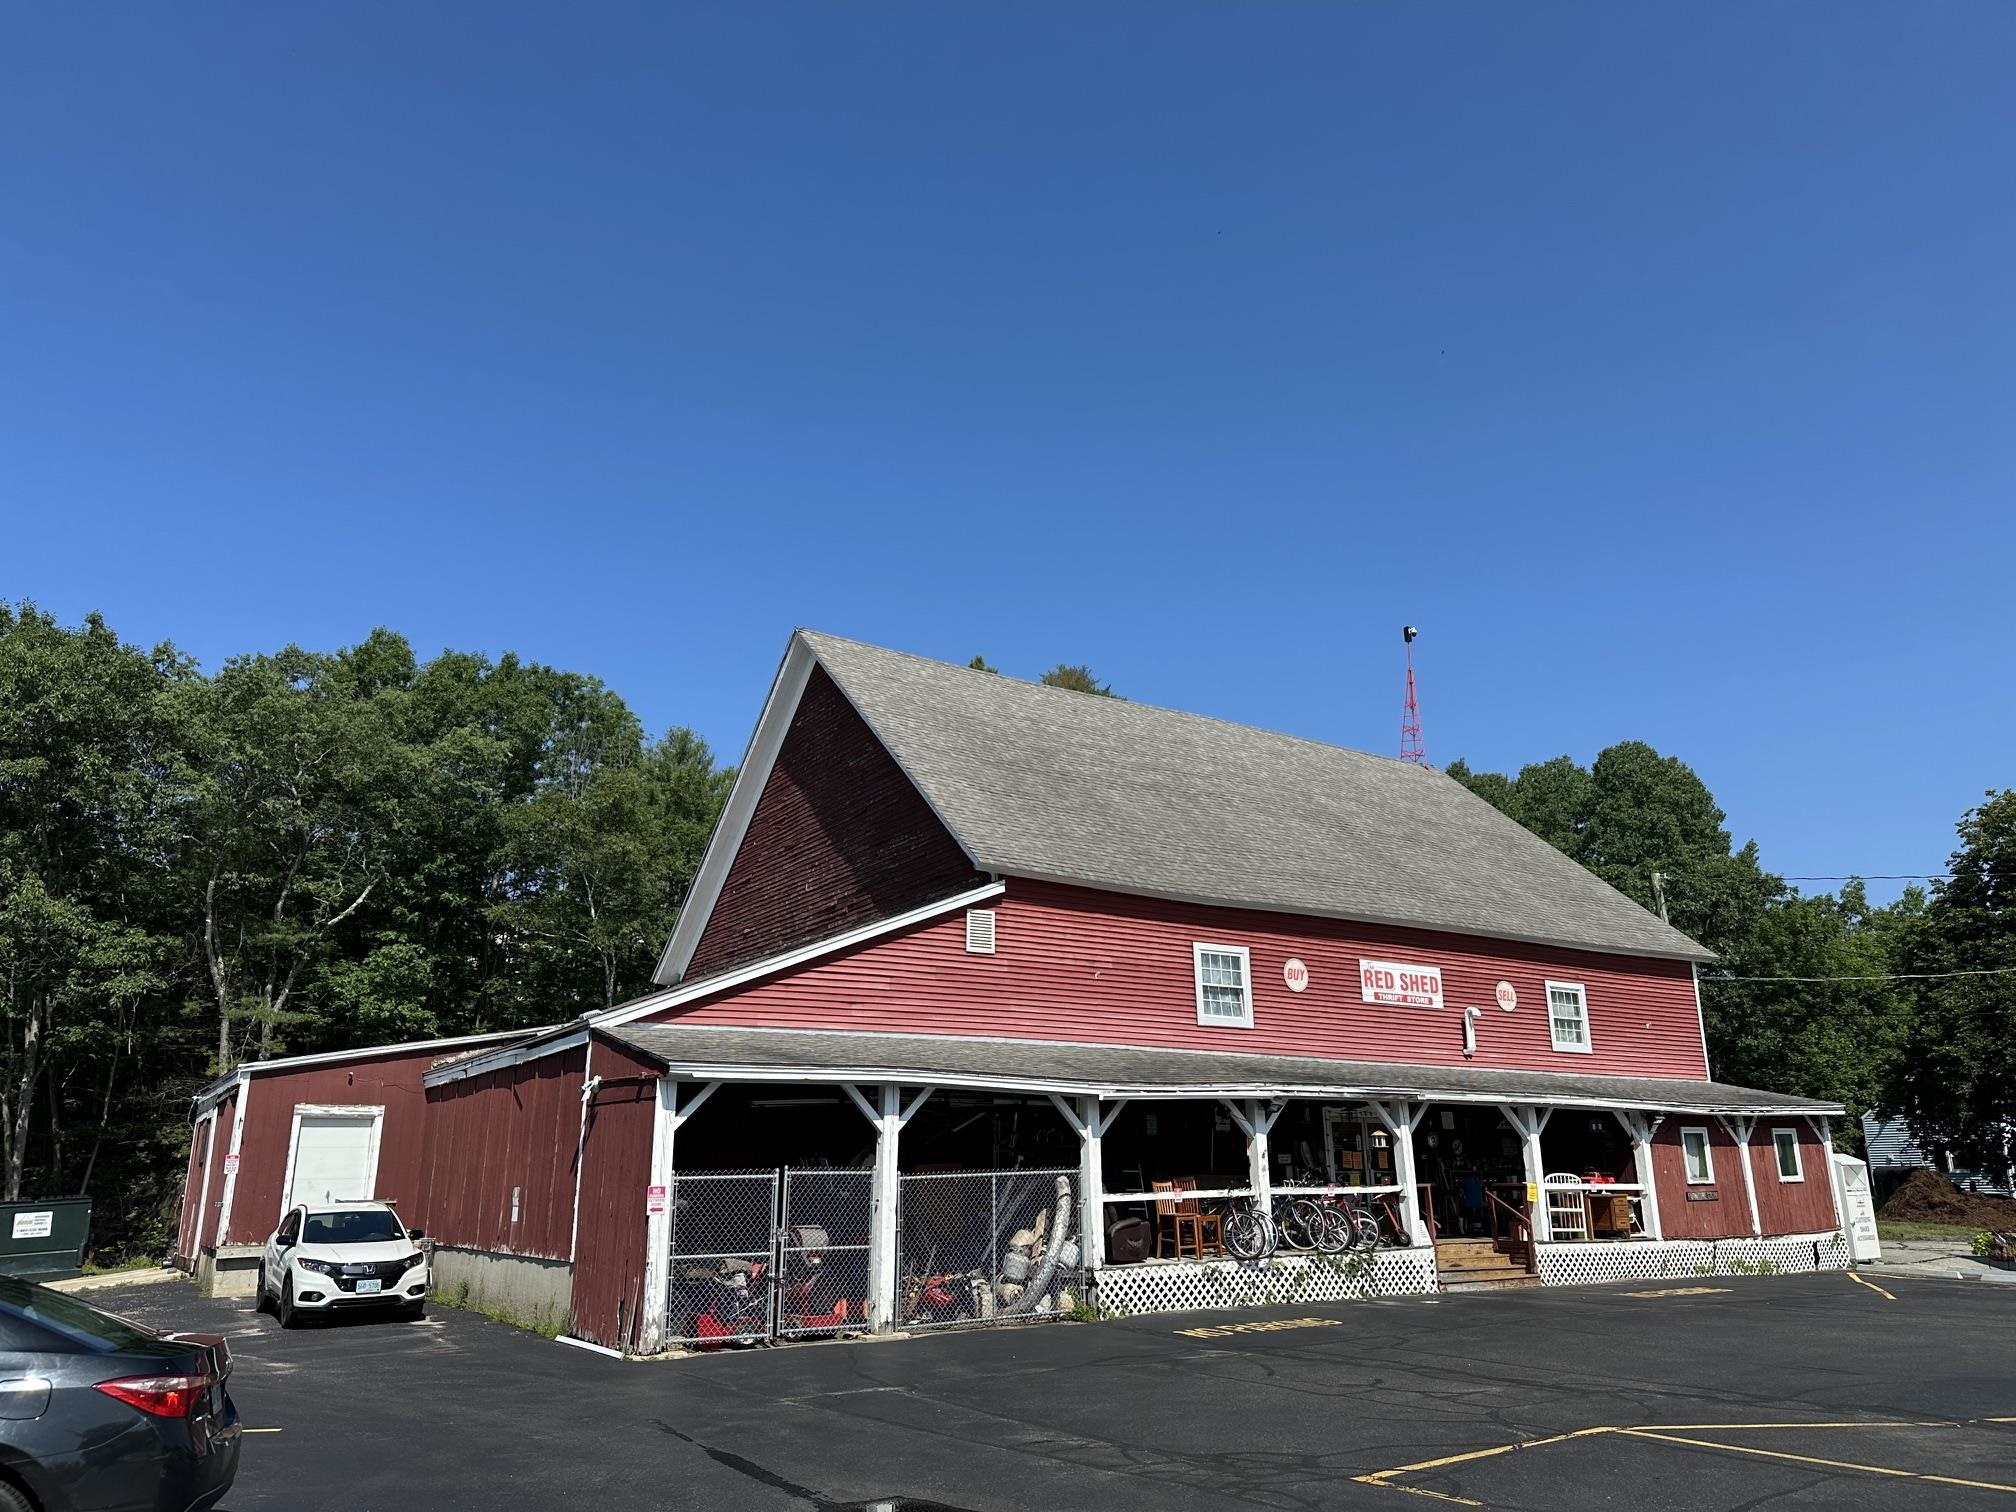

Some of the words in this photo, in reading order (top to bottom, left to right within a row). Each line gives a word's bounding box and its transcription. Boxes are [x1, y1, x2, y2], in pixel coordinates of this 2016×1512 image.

[1287, 968, 1305, 981] BUY
[1363, 969, 1394, 989] RED
[1400, 973, 1439, 993] SHED
[1378, 993, 1404, 1002] THRIFT
[1407, 996, 1429, 1004] STORE
[1498, 989, 1515, 1002] SELL
